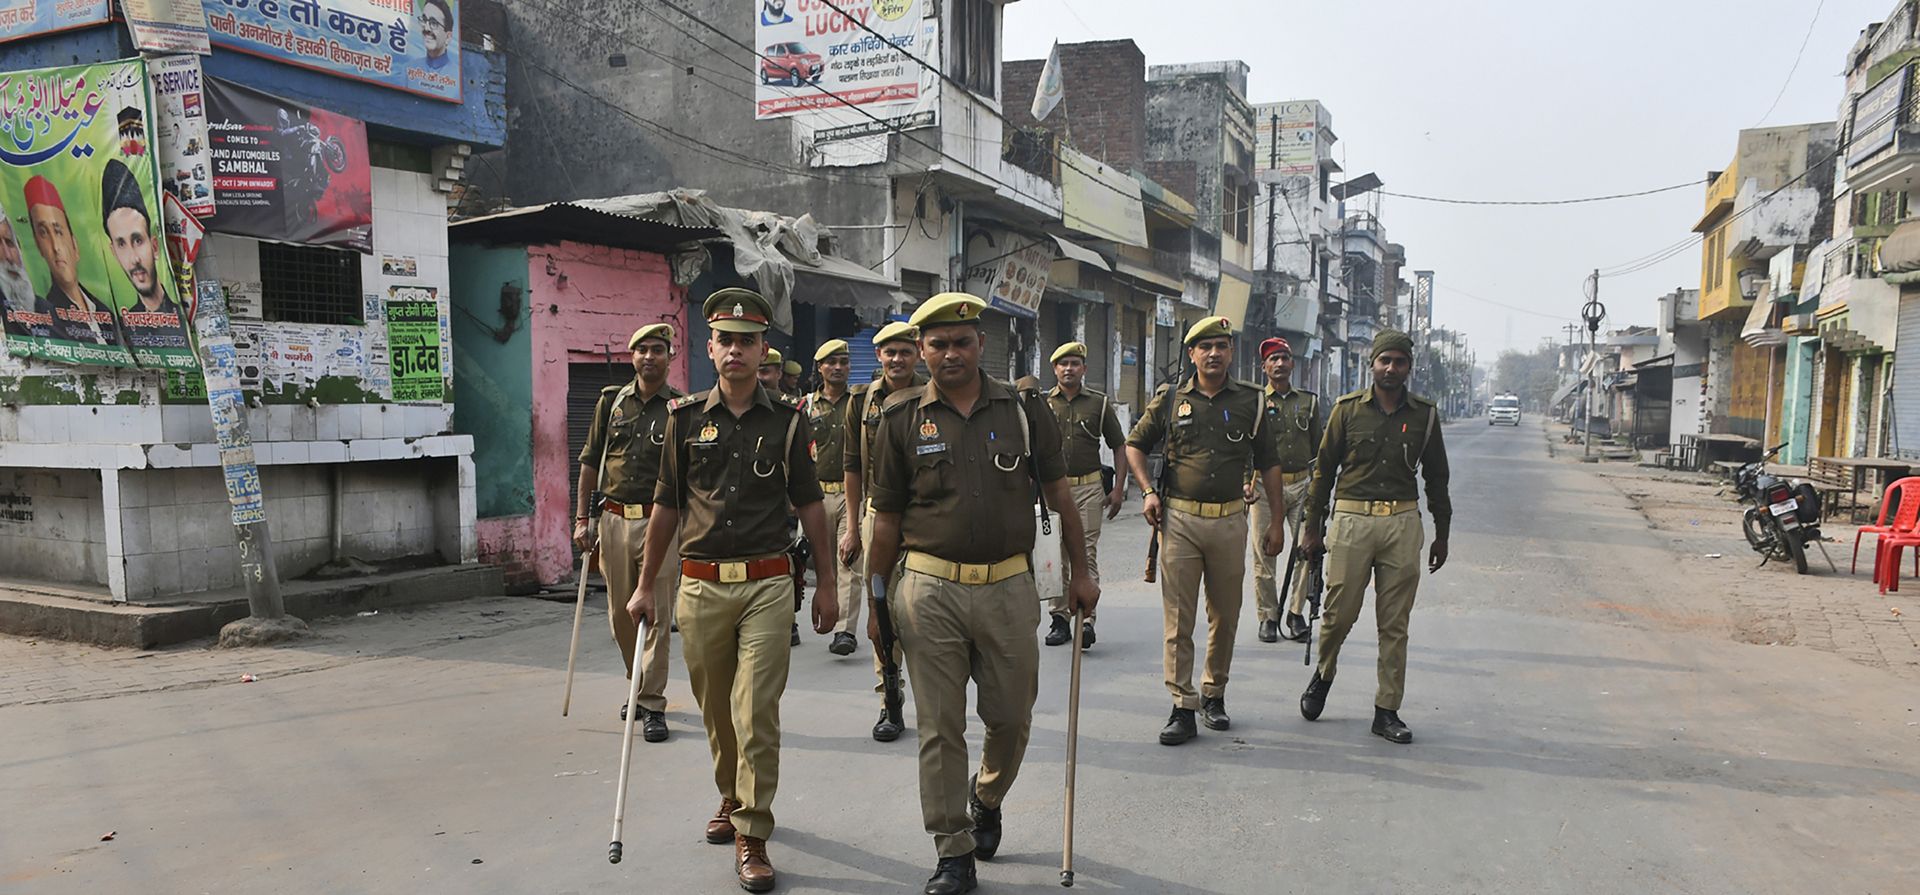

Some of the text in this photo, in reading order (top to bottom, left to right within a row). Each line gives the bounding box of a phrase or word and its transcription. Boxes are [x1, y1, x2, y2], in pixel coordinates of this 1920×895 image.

[327, 8, 383, 45] कल
[388, 17, 409, 54] है
[806, 7, 870, 37] LUCKY
[209, 13, 236, 34] पानी
[239, 24, 282, 47] अनमोल
[284, 30, 294, 52] है
[295, 38, 327, 57] इसकी
[373, 54, 392, 74] करें
[829, 42, 849, 57] कार
[162, 69, 200, 93] SERVICE
[227, 135, 259, 145] COMES TO
[231, 149, 280, 161] AUTOMOBILES
[219, 160, 268, 174] SAMBHAL
[388, 306, 404, 321] गुप्त
[405, 303, 420, 317] रोगी
